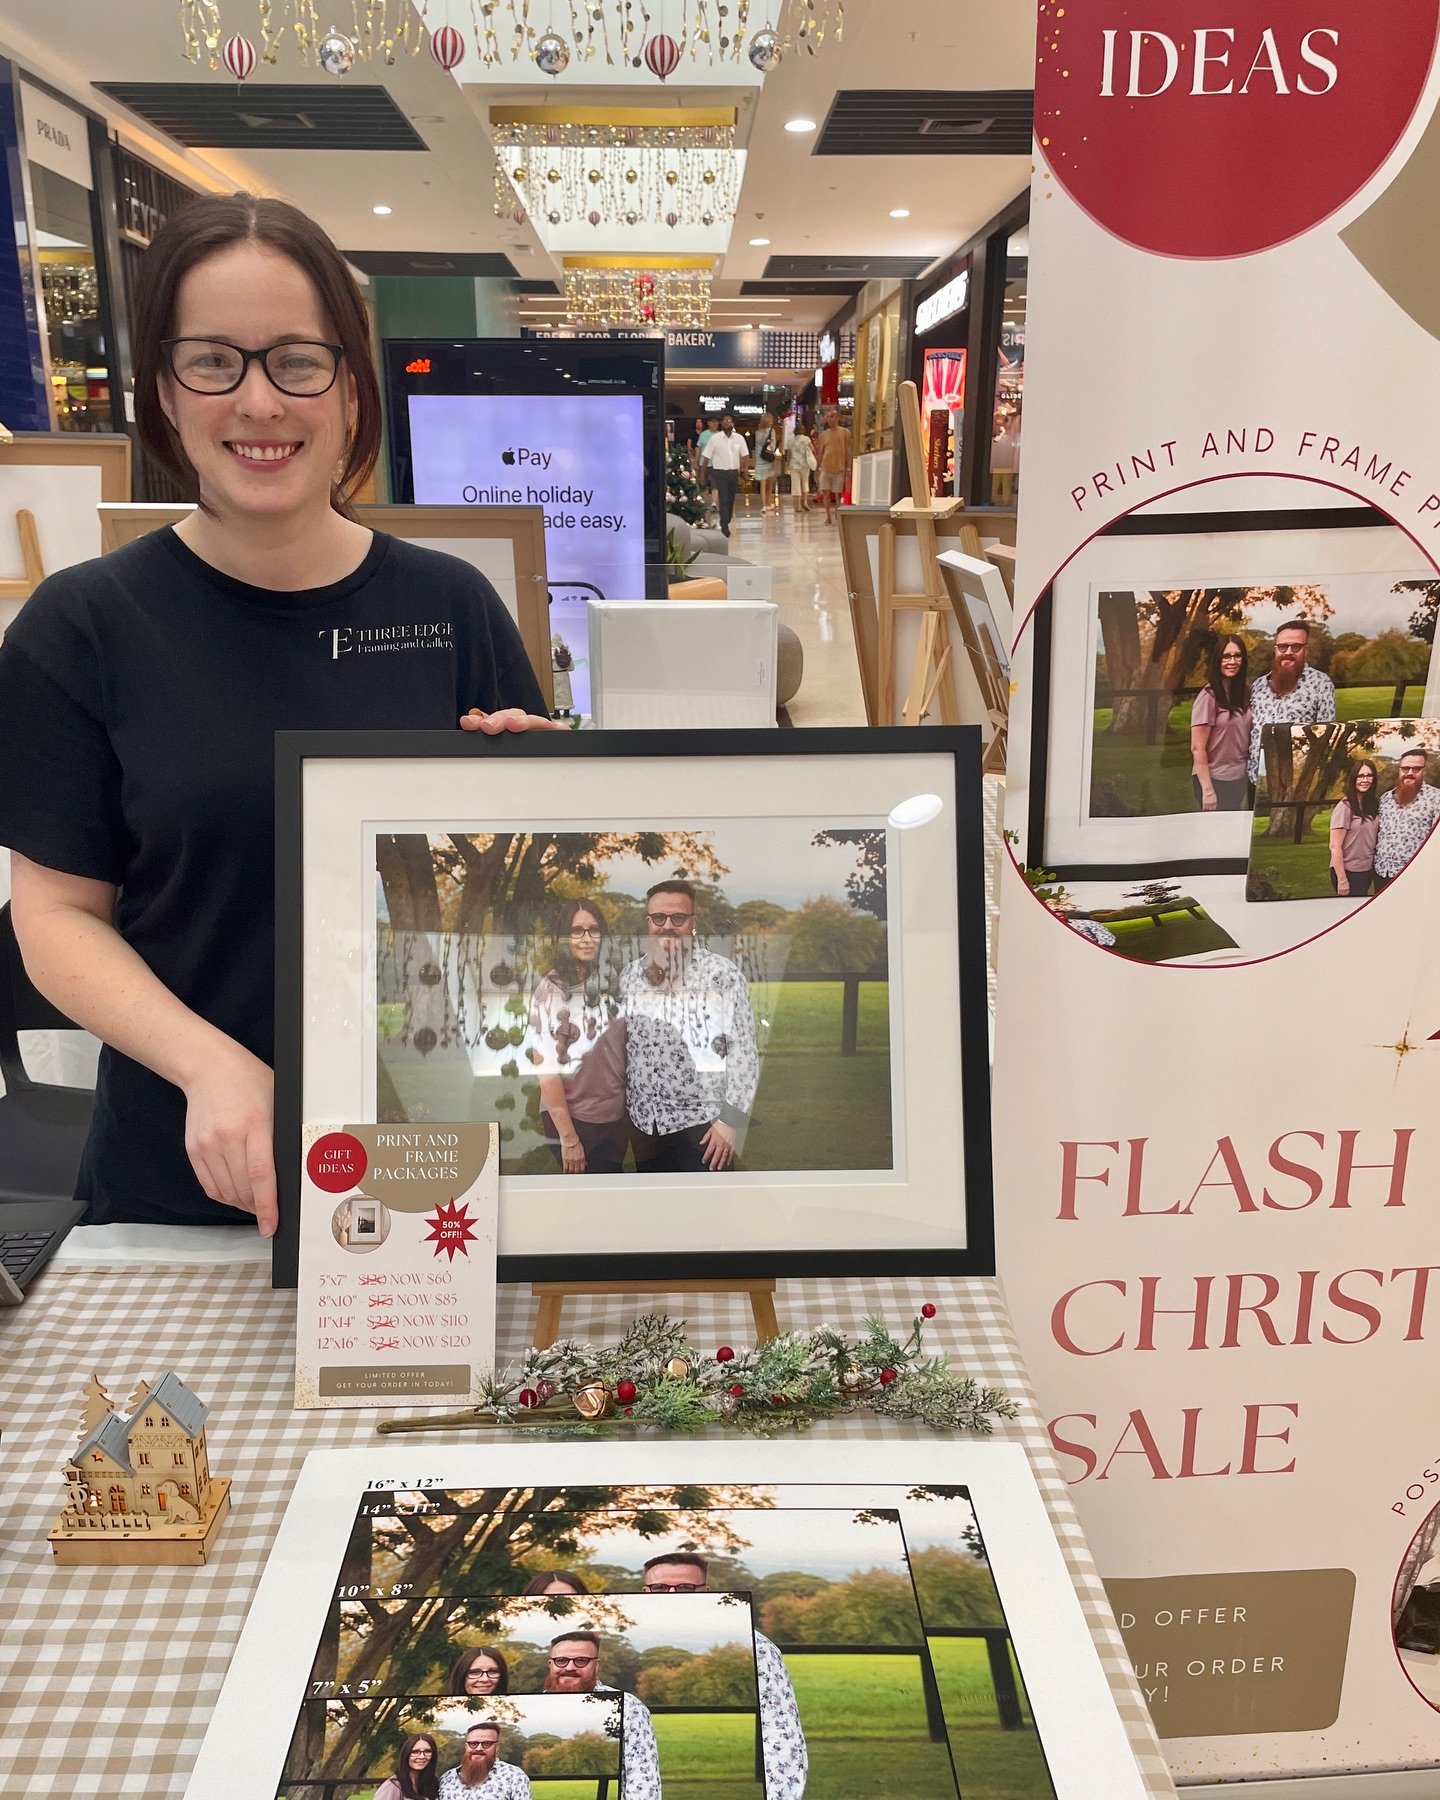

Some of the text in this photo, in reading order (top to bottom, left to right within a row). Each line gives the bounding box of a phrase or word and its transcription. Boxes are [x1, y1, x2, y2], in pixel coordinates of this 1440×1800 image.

[1099, 28, 1340, 98] IDEAS
[668, 333, 715, 348] BAKERY,
[518, 449, 552, 470] Pay
[1070, 440, 1177, 512] PRINT
[1201, 428, 1275, 458] AND
[1298, 431, 1412, 497] FRAME
[462, 485, 594, 507] Online holiday
[543, 511, 627, 532] ade easy.
[356, 622, 453, 641] THREE EDGE
[358, 637, 454, 653] Framing and Gallery
[376, 1133, 459, 1147] PRINT AND
[323, 1149, 352, 1160] GIFT
[405, 1150, 459, 1163] FRAME
[318, 1163, 355, 1174] IDEAS
[373, 1166, 459, 1180] PACKAGES
[1055, 1128, 1416, 1221] FLASH
[442, 1220, 461, 1229] 50%
[440, 1230, 463, 1239] OFF!!
[390, 1273, 425, 1286] NOW
[427, 1271, 452, 1286] $60
[397, 1293, 433, 1307] NOW
[434, 1293, 458, 1307] $85
[403, 1314, 438, 1327] NOW
[441, 1313, 468, 1327] $110
[403, 1335, 438, 1348] NOW
[441, 1334, 471, 1348] $120
[424, 1380, 454, 1388] TODAY!
[1046, 1402, 1299, 1485] SALE
[374, 1587, 386, 1596] x
[1154, 1606, 1248, 1628] OFFER
[1134, 1655, 1285, 1680] UR ORDER
[339, 1684, 352, 1694] x
